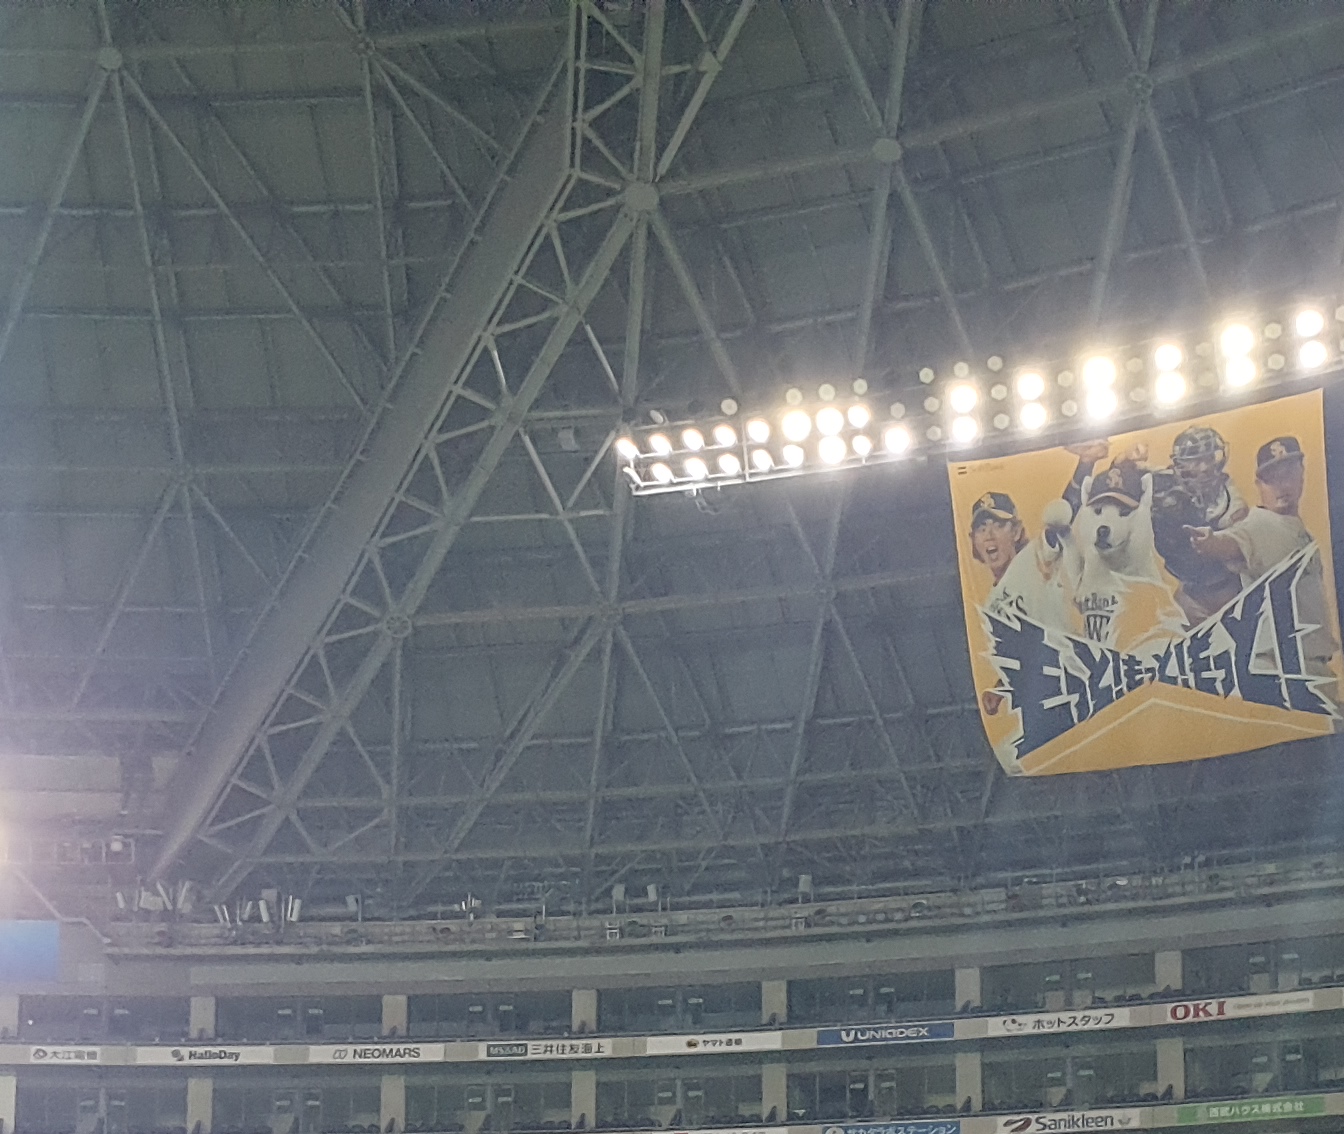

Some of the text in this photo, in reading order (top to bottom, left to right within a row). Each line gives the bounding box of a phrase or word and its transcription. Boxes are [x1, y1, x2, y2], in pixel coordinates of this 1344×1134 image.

[1170, 1000, 1227, 1020] OKI
[353, 1046, 421, 1060] NEOMARS
[1035, 1113, 1114, 1133] Sanikleen
